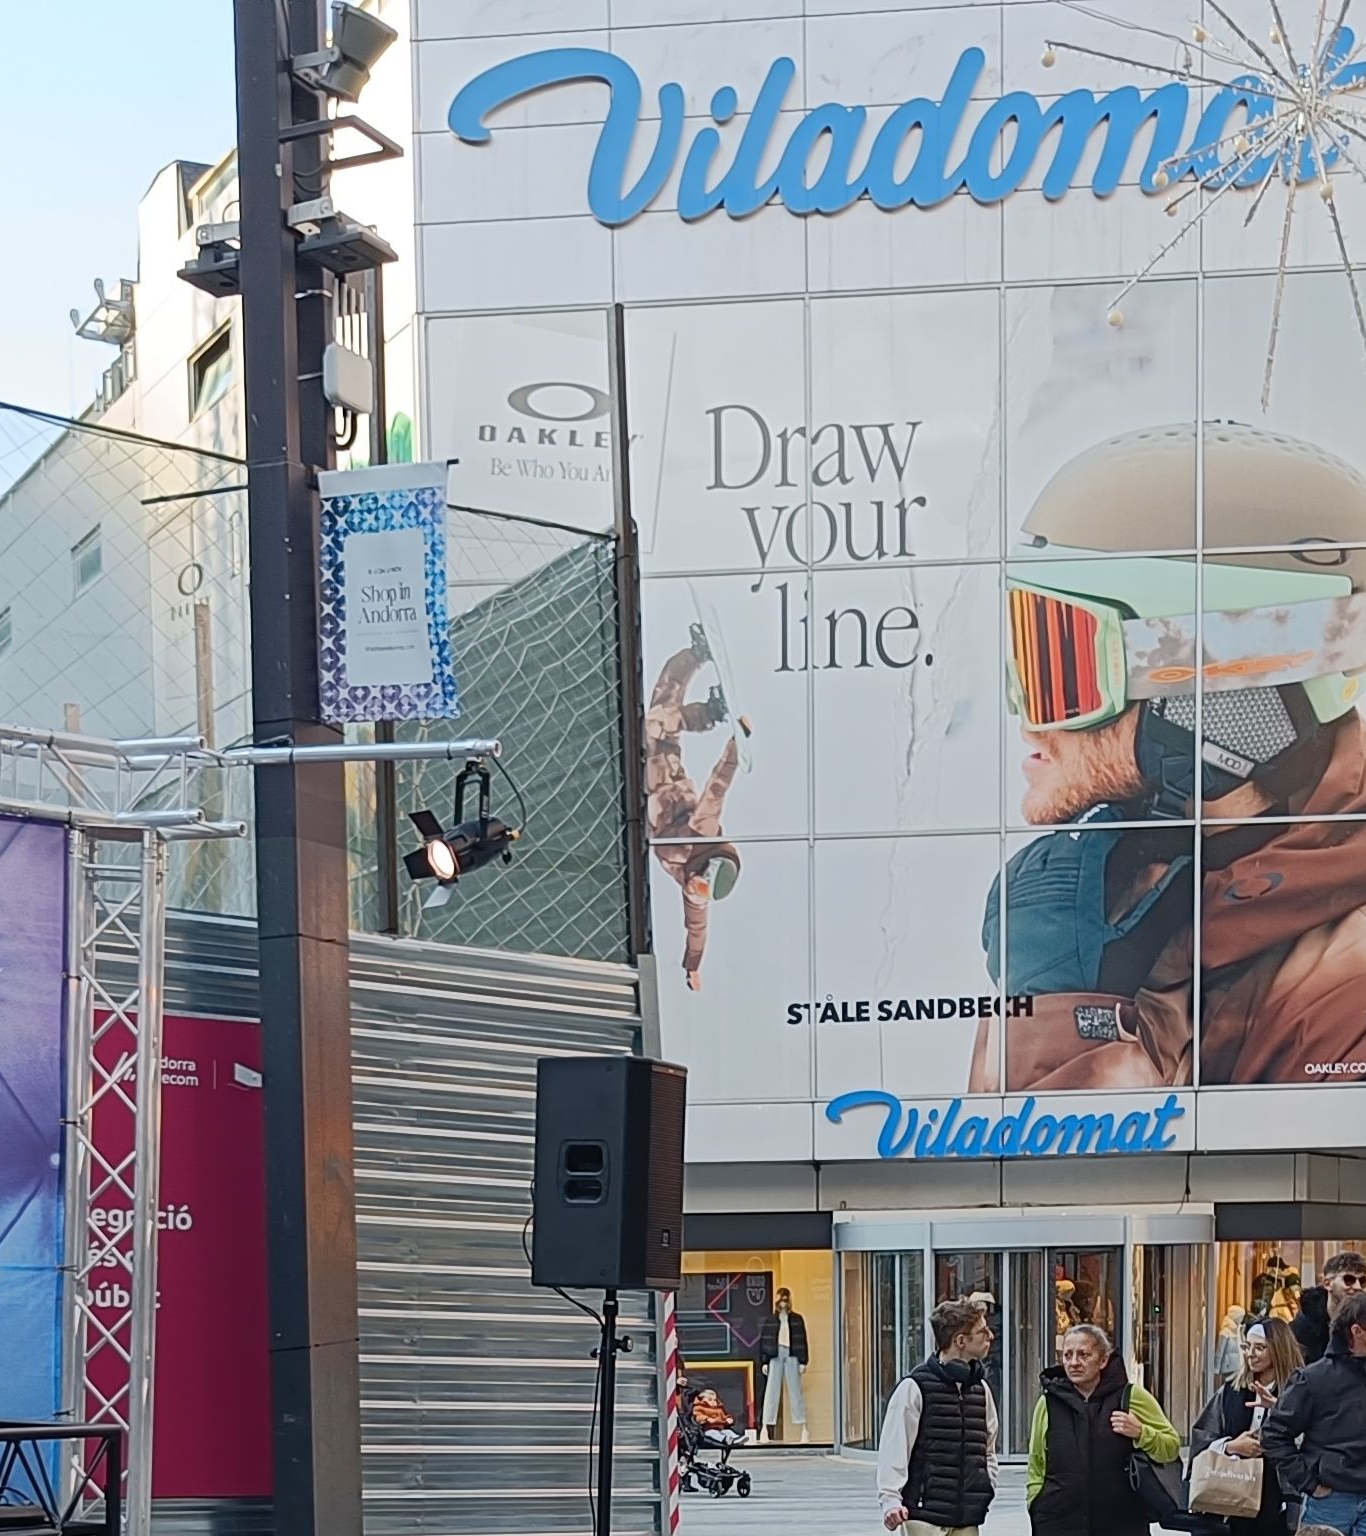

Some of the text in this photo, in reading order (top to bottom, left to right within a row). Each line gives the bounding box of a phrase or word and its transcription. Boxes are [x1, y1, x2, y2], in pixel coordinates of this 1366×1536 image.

[491, 457, 512, 477] Be
[517, 459, 554, 479] Who
[559, 461, 589, 481] You
[706, 404, 924, 493] Draw
[742, 492, 927, 592] your
[358, 605, 417, 624] Andorra
[361, 581, 411, 606] Shop in
[773, 582, 936, 672] line.
[787, 995, 1033, 1024] STÅLE SANDBECH
[826, 1091, 1185, 1158] Viladomat
